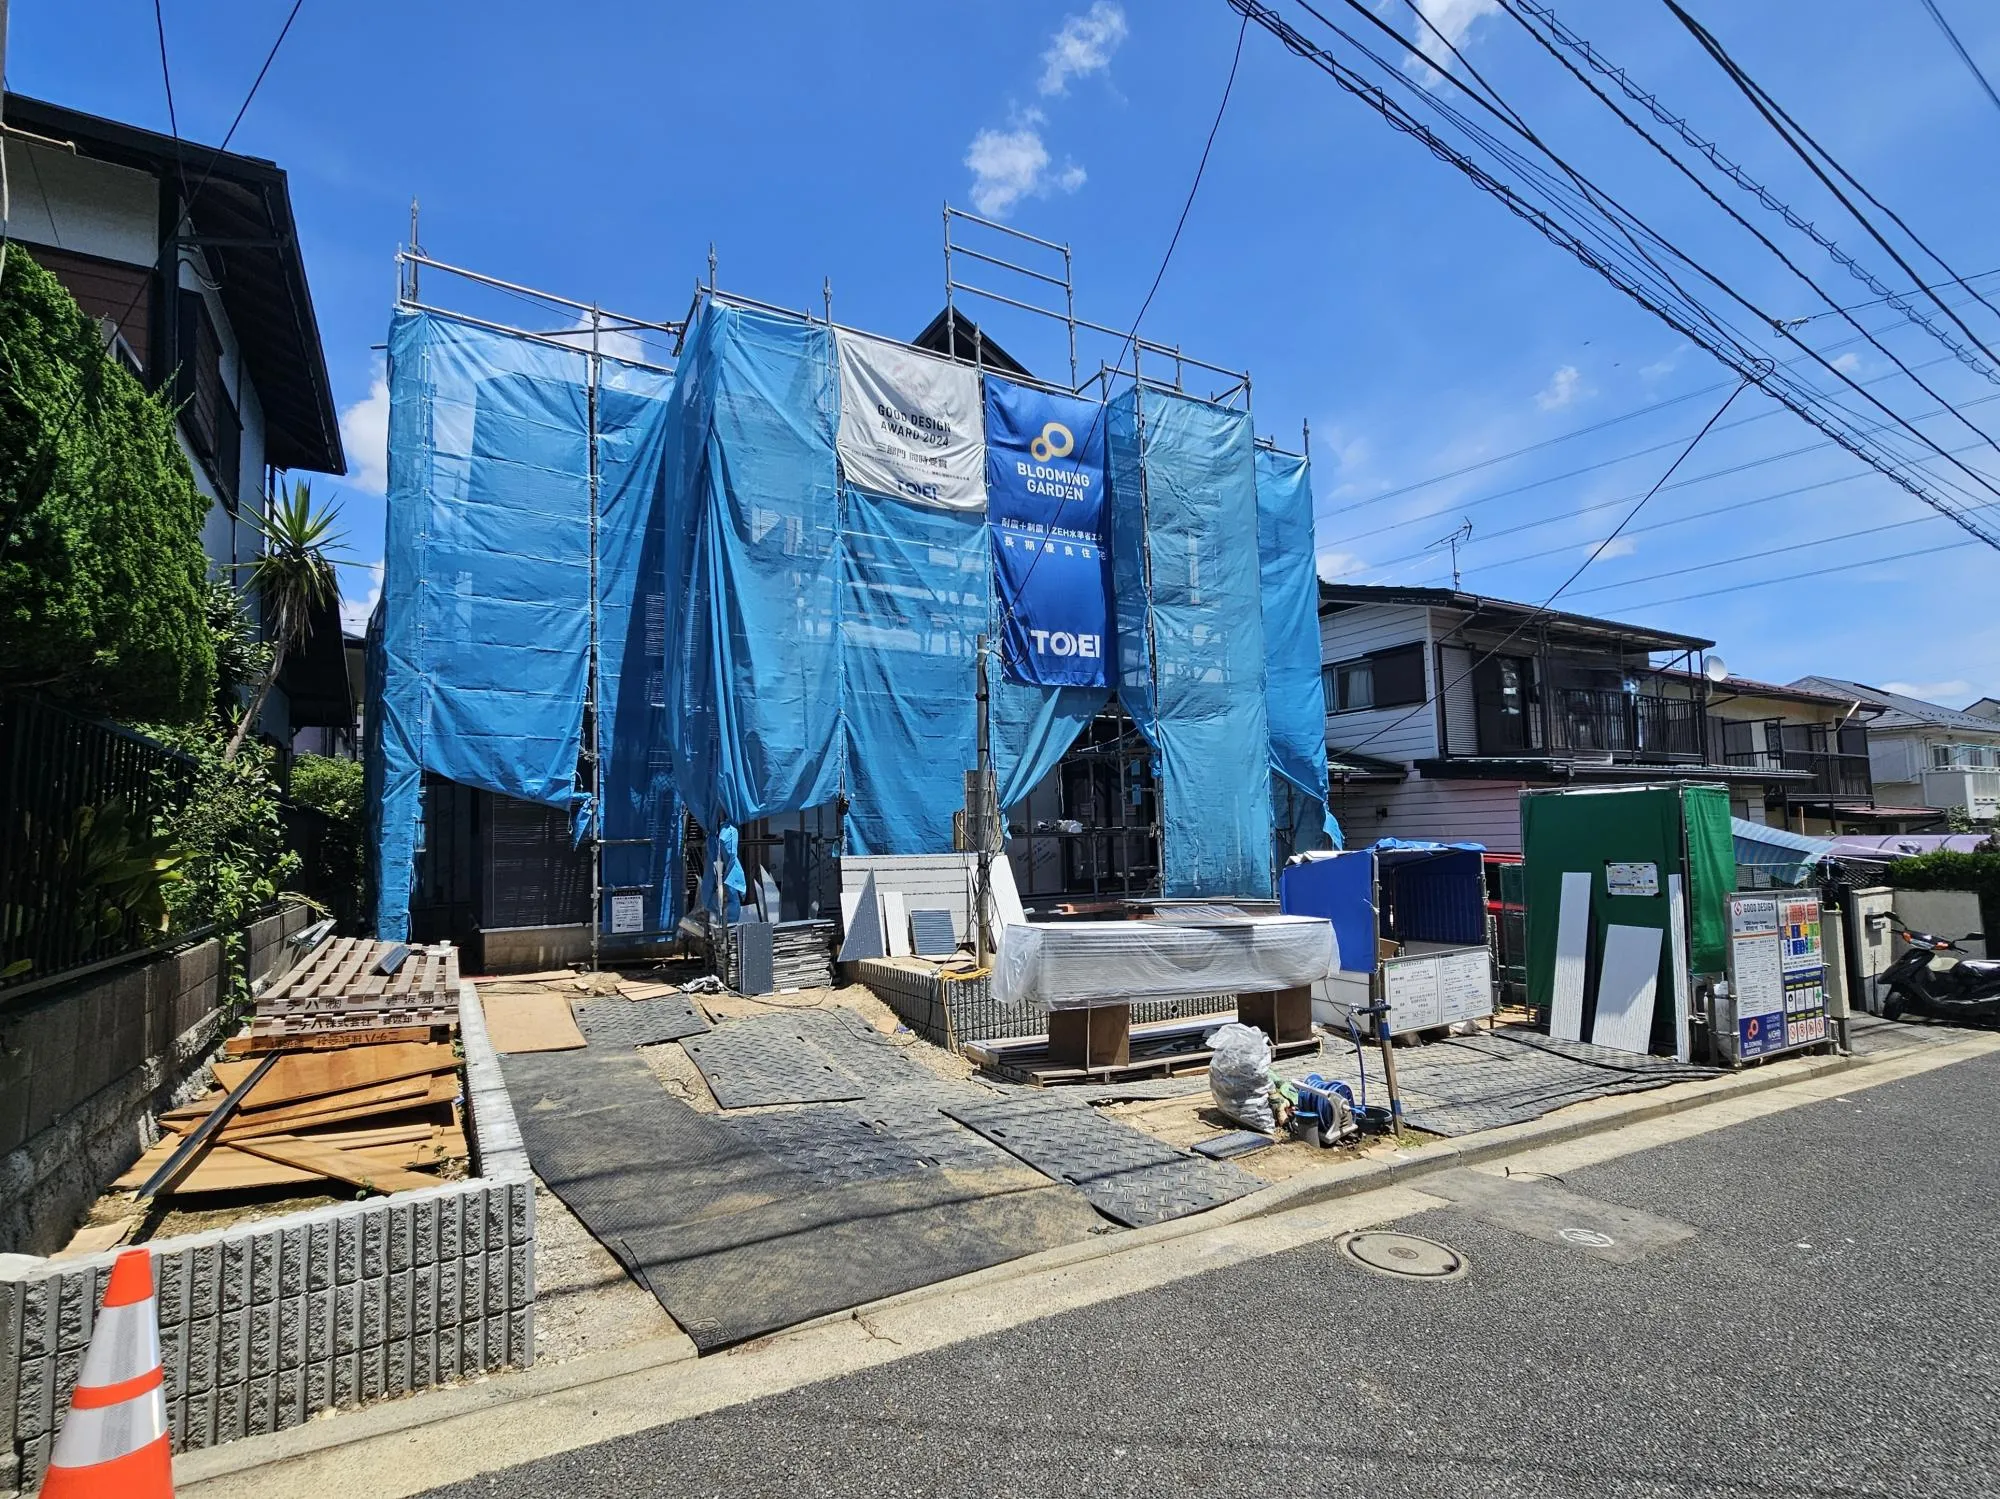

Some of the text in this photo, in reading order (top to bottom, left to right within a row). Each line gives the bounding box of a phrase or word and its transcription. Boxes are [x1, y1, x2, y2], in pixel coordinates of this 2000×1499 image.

[877, 404, 952, 433] GOOD DESIGN
[880, 421, 949, 447] AWARD 2024
[1016, 462, 1090, 487] BLOOMING
[1027, 480, 1084, 501] GARDEN
[1030, 629, 1100, 658] TOEI
